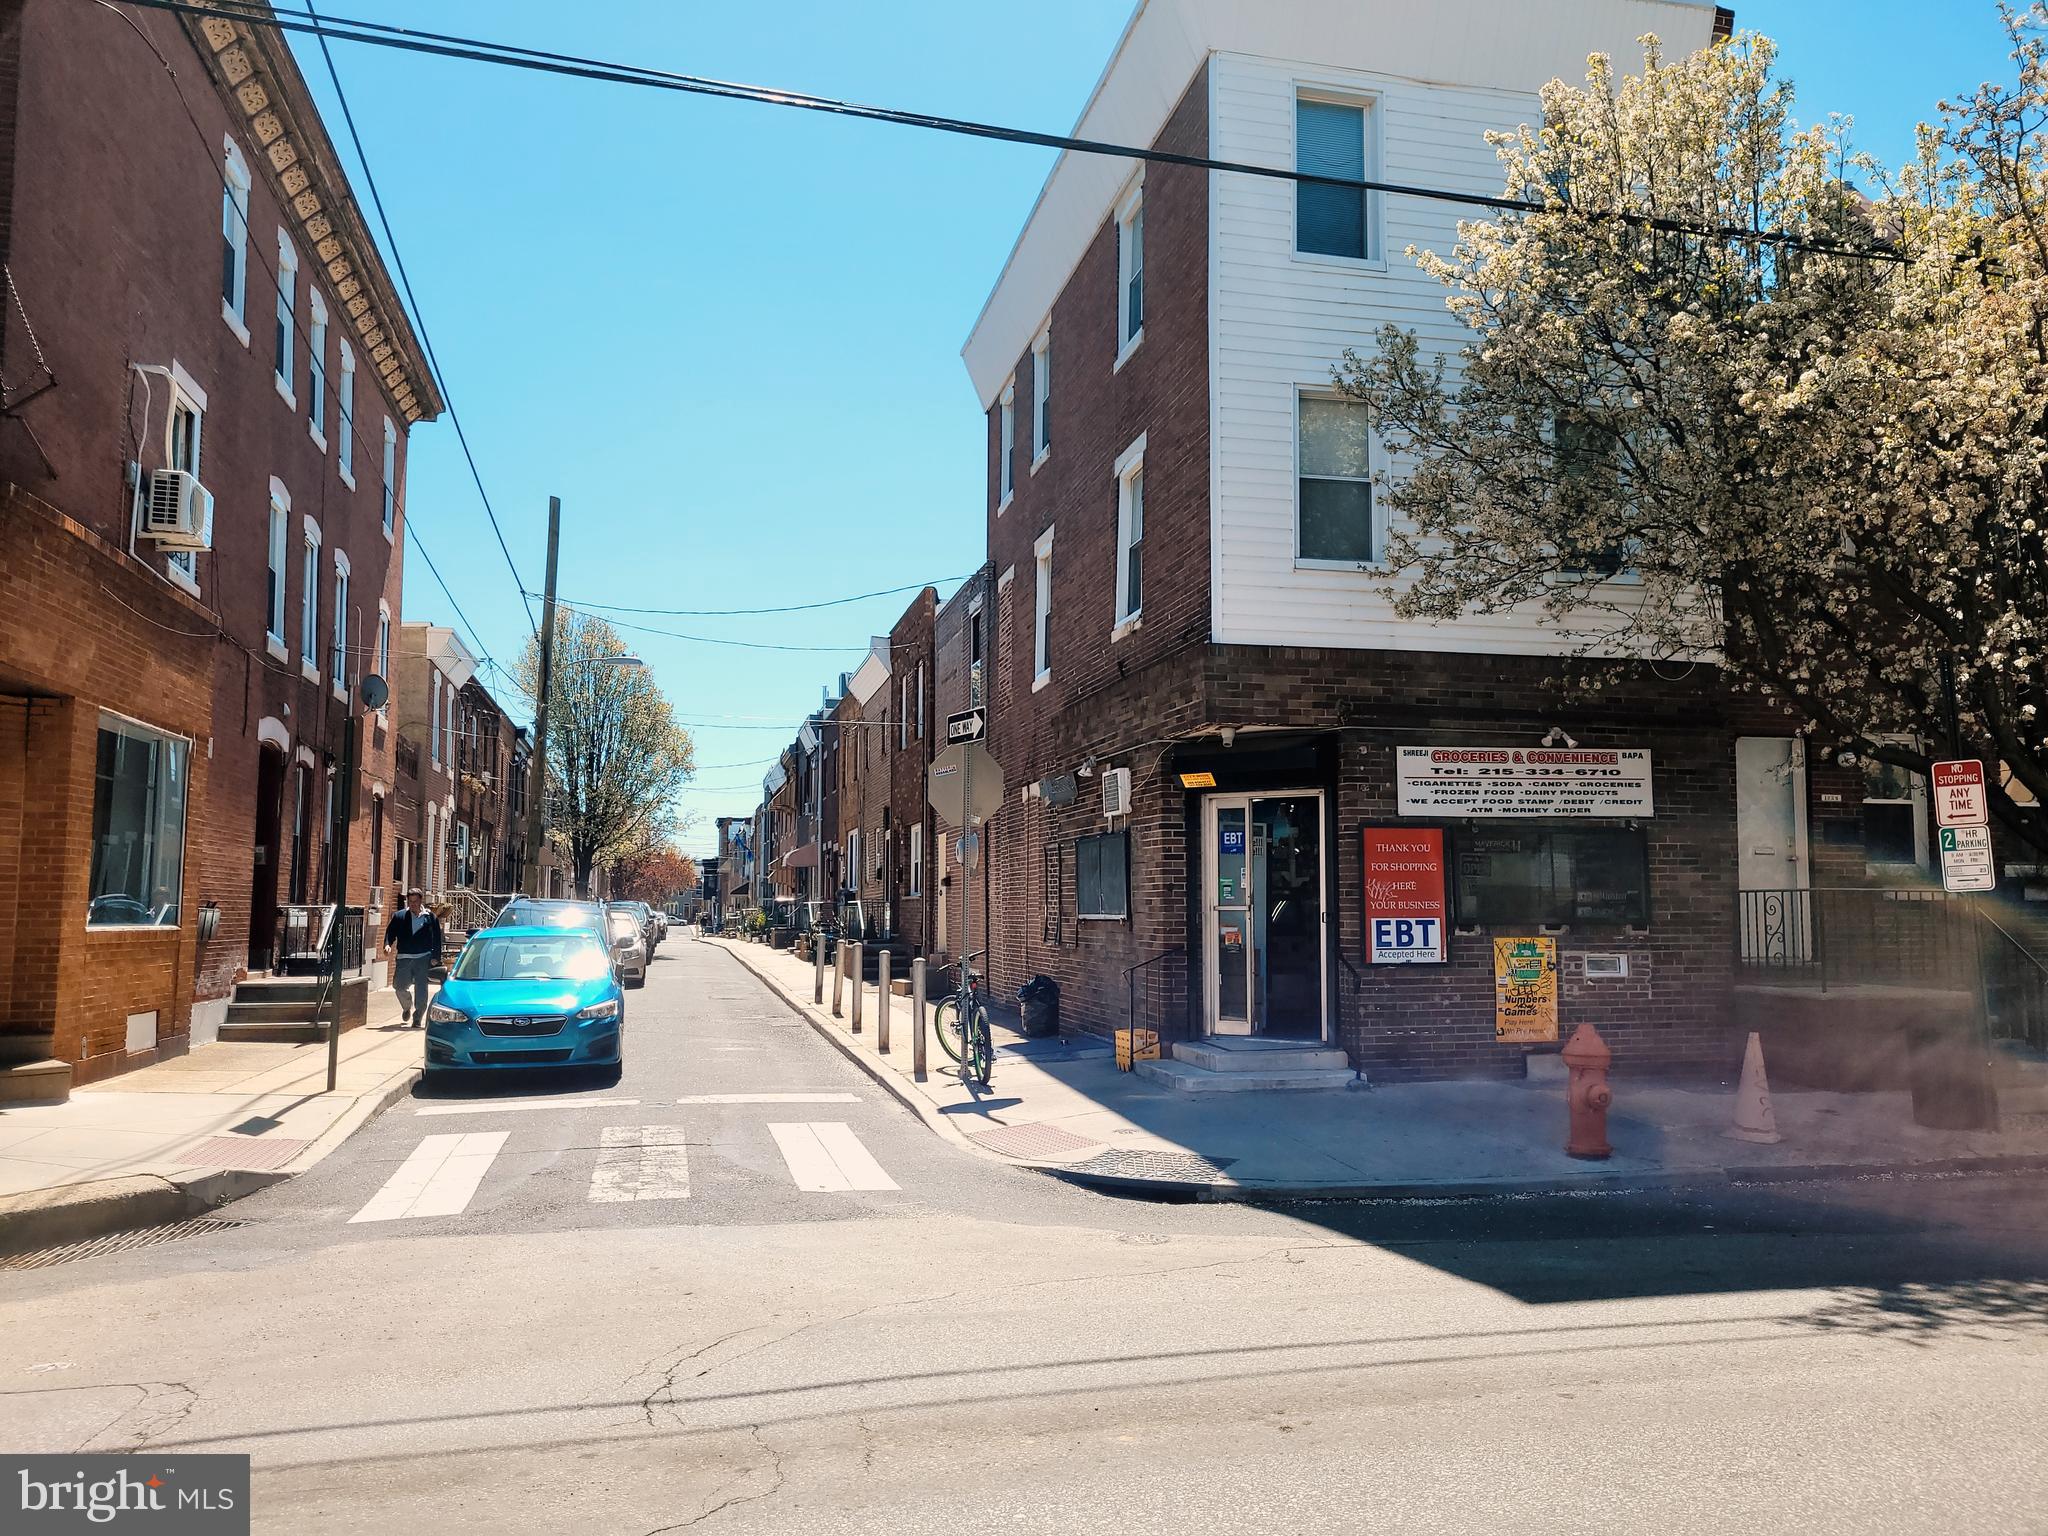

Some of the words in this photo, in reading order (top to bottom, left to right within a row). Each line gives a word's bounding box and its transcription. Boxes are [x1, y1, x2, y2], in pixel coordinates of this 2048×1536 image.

[951, 722, 961, 736] ONE
[962, 719, 973, 734] WAY
[1403, 749, 1429, 757] SHREEJI
[1431, 750, 1509, 764] GROCERIES
[1512, 750, 1525, 764] &
[1527, 751, 1618, 765] CONVENIENCE
[1430, 767, 1469, 775] Tel:
[1478, 768, 1621, 776] 215-334-6710
[1951, 764, 1963, 773] NO
[1938, 773, 1979, 785] STOPPING
[1950, 787, 1970, 799] ANY
[1949, 799, 1973, 811] TIME
[1224, 832, 1243, 844] EBT
[1965, 829, 1978, 838] HR
[1943, 832, 1953, 848] 2
[1956, 839, 1987, 849] PARKING
[1376, 843, 1409, 852] THANK
[1411, 843, 1431, 852] YOU
[1371, 862, 1389, 871] FOR
[1390, 862, 1437, 871] SHOPPING
[1392, 881, 1417, 890] HERE
[1370, 901, 1396, 909] YOUR
[1398, 901, 1440, 909] BUSINESS
[1375, 919, 1436, 948] EBT
[1378, 950, 1415, 959] Accepted
[1416, 950, 1435, 958] Here
[1505, 995, 1547, 1004] Numbers
[1504, 1007, 1538, 1016] Games
